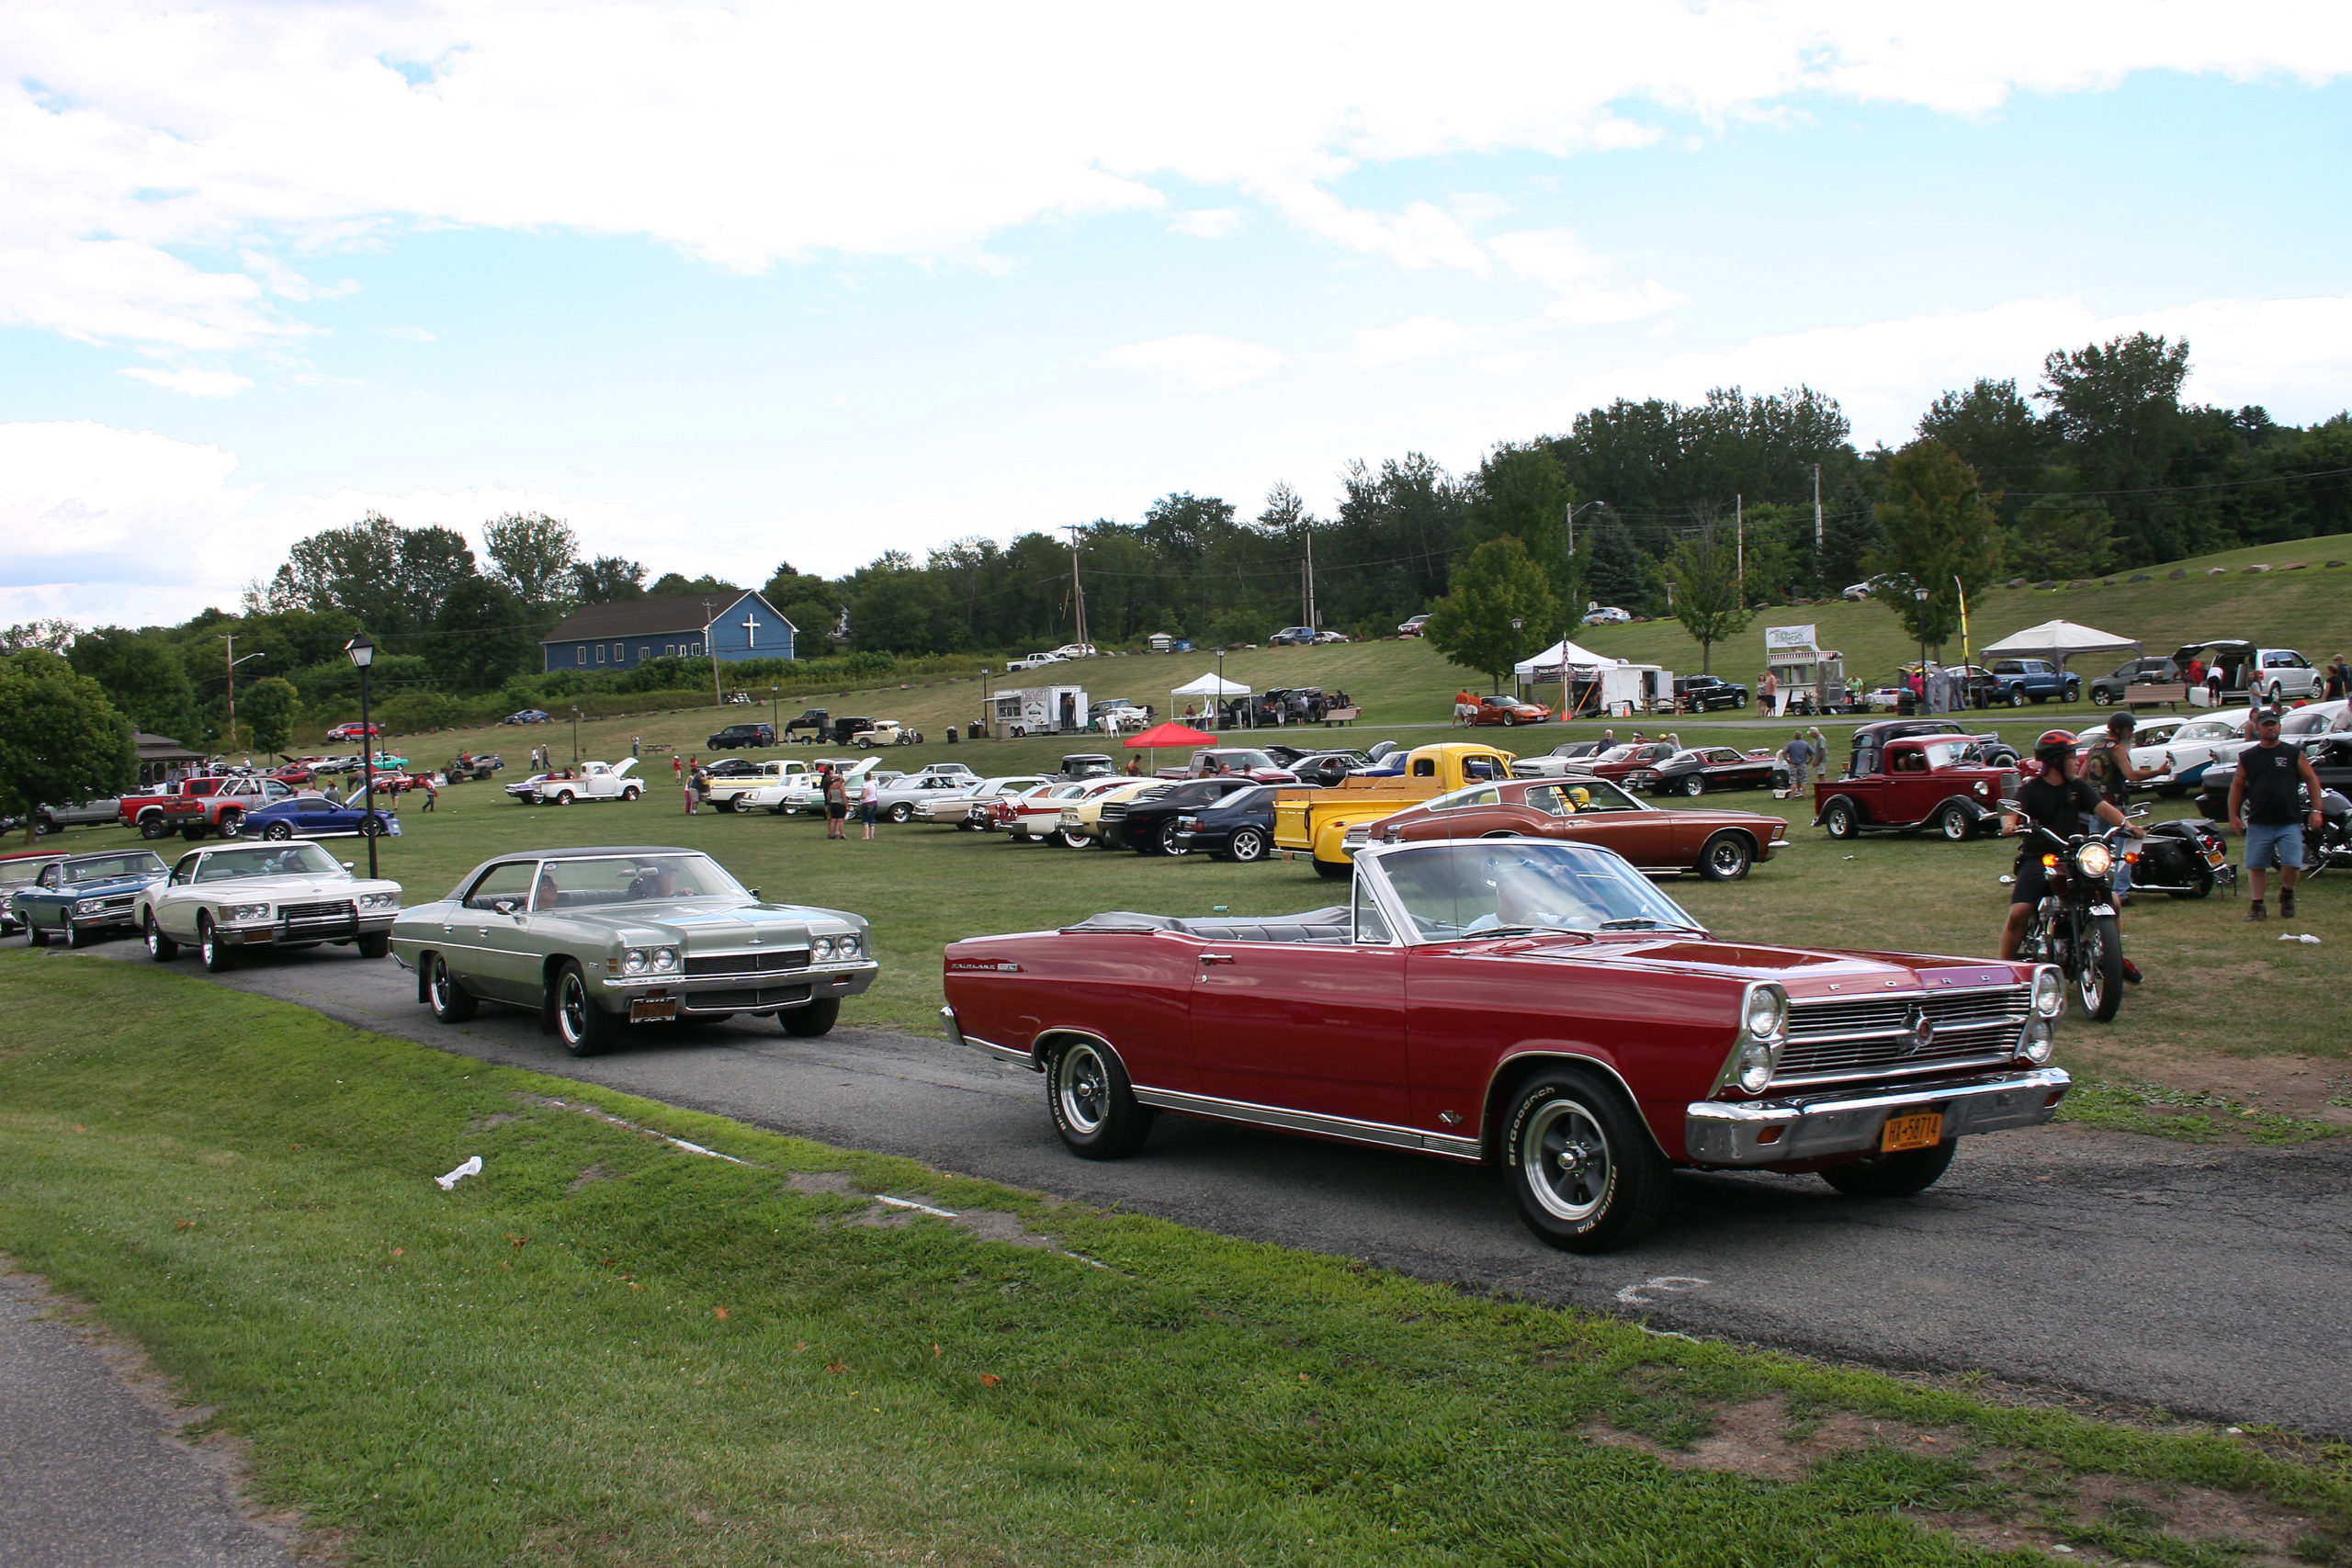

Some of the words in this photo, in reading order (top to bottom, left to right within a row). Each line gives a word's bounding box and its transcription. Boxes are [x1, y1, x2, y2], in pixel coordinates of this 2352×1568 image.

[1829, 975, 1990, 991] FORD
[1509, 1087, 1555, 1166] BFGoodrich
[1597, 1165, 1617, 1221] Radial
[1577, 1219, 1596, 1234] T/A
